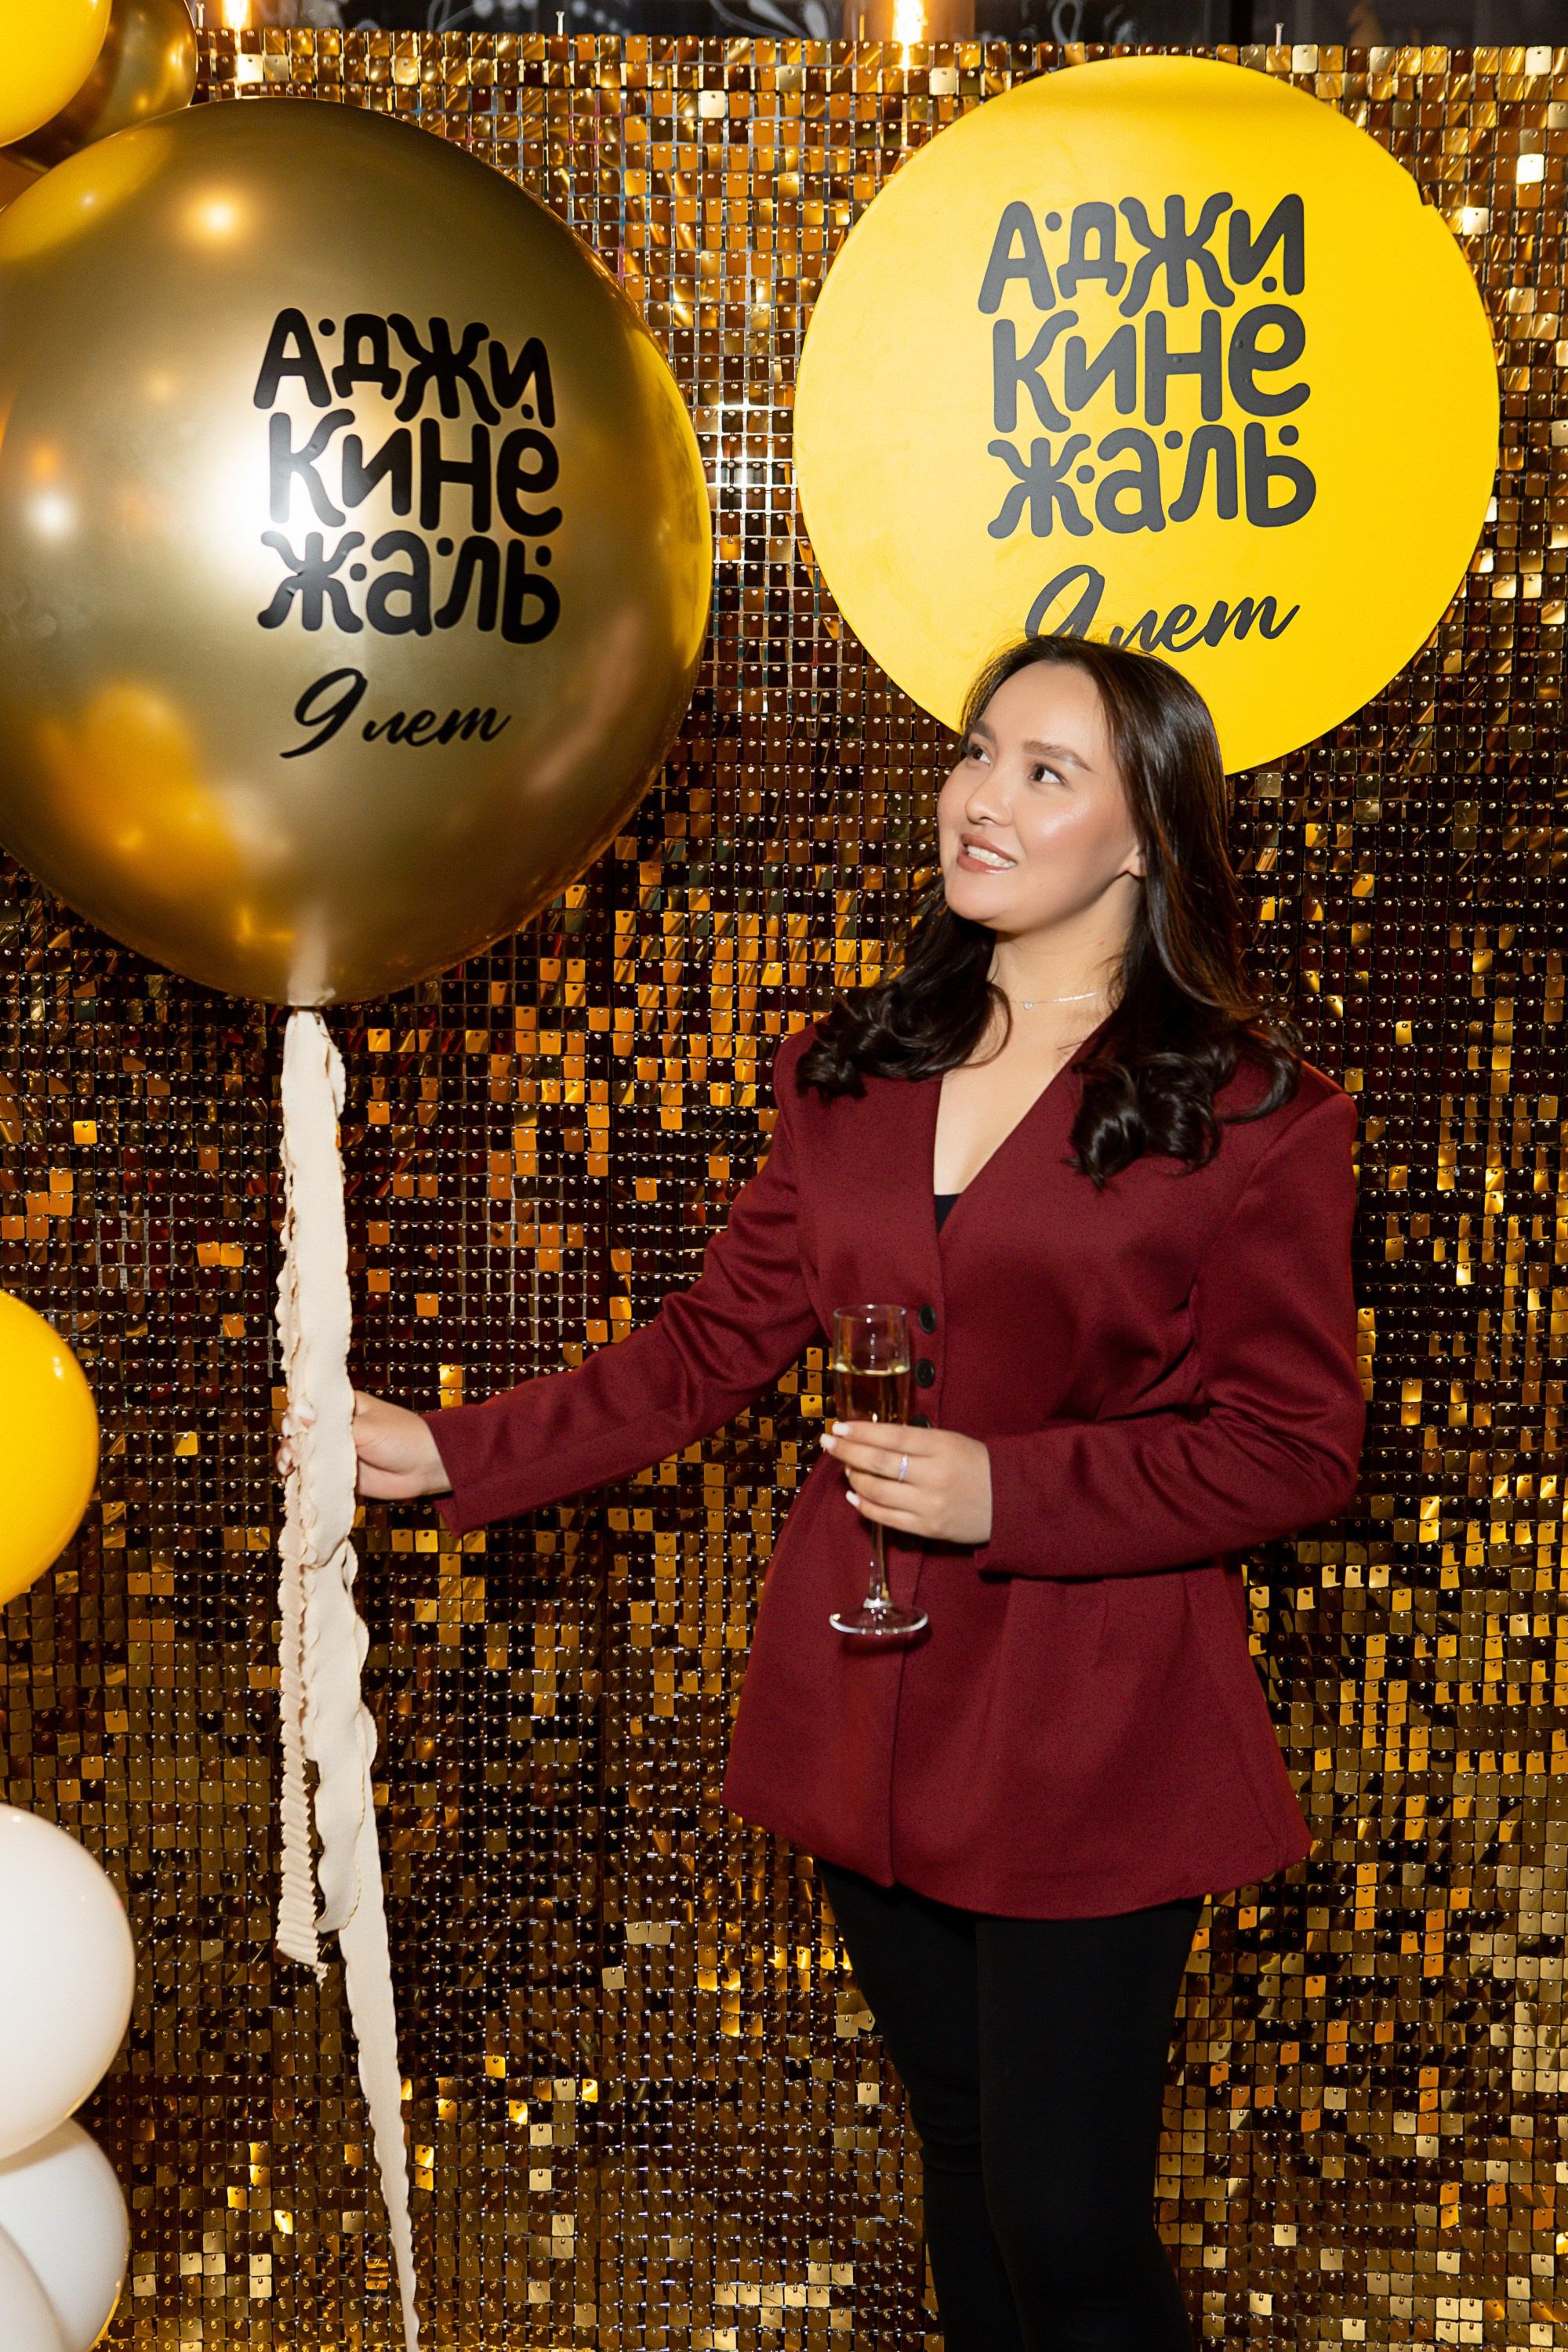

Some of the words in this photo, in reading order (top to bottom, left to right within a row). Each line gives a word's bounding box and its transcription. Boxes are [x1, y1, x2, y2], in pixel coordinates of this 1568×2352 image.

[1109, 595, 1300, 652] лет
[279, 668, 368, 759] 9
[361, 706, 512, 746] лет
